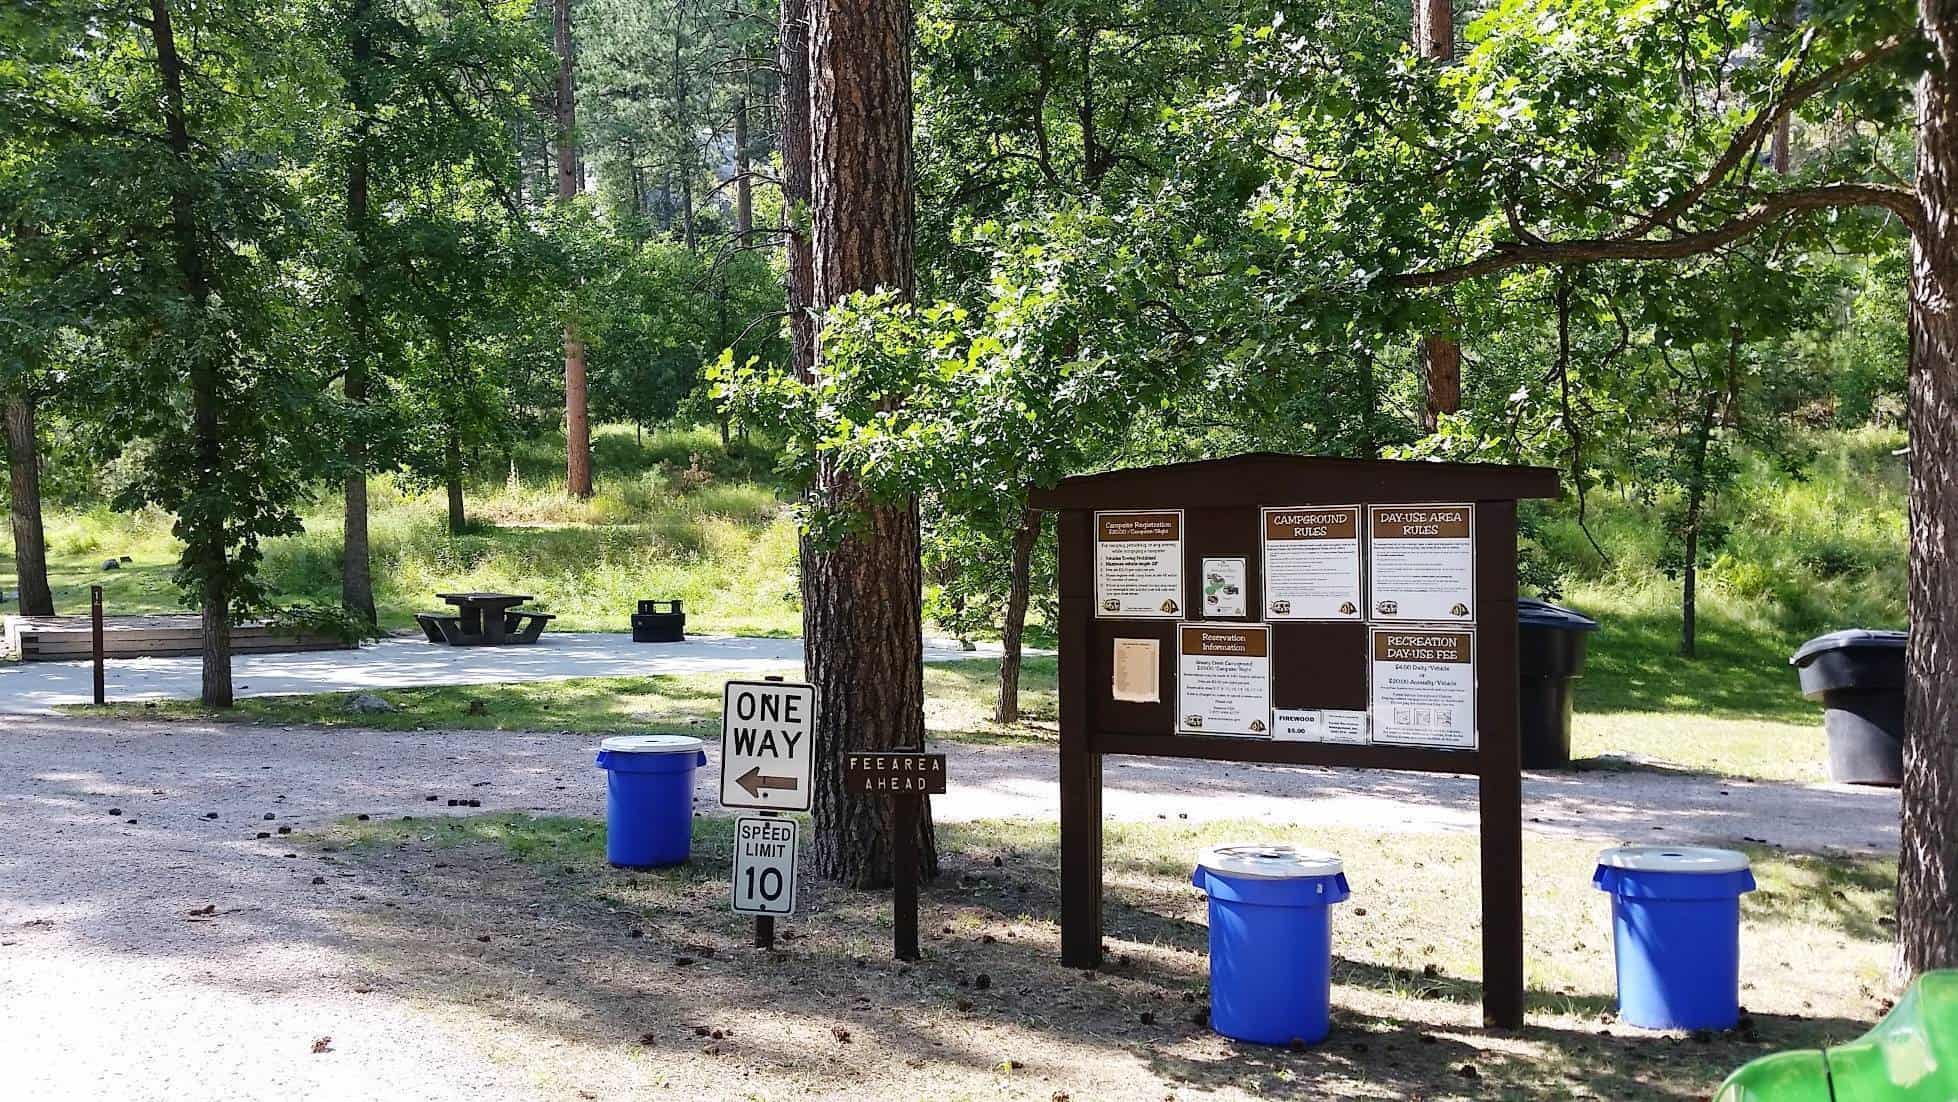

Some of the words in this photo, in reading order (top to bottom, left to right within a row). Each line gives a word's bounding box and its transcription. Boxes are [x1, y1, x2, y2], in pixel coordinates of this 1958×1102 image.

[1274, 514, 1348, 525] CAMPGROUND
[1380, 513, 1427, 523] DAY-USE
[1428, 512, 1462, 522] AREA
[1134, 521, 1172, 530] Registration
[1403, 525, 1439, 535] RULES
[1294, 526, 1328, 537] RULES
[1202, 633, 1246, 642] Reservation
[1387, 636, 1457, 647] RECREATION
[1202, 643, 1246, 652] Information
[1387, 648, 1433, 659] DAY-USE
[1436, 650, 1458, 660] FEE
[736, 691, 802, 724] ONE
[734, 727, 802, 759] WAY
[865, 777, 926, 791] AHEAD
[742, 825, 791, 842] SPEED
[745, 842, 786, 858] LIMIT
[745, 865, 783, 901] 10
